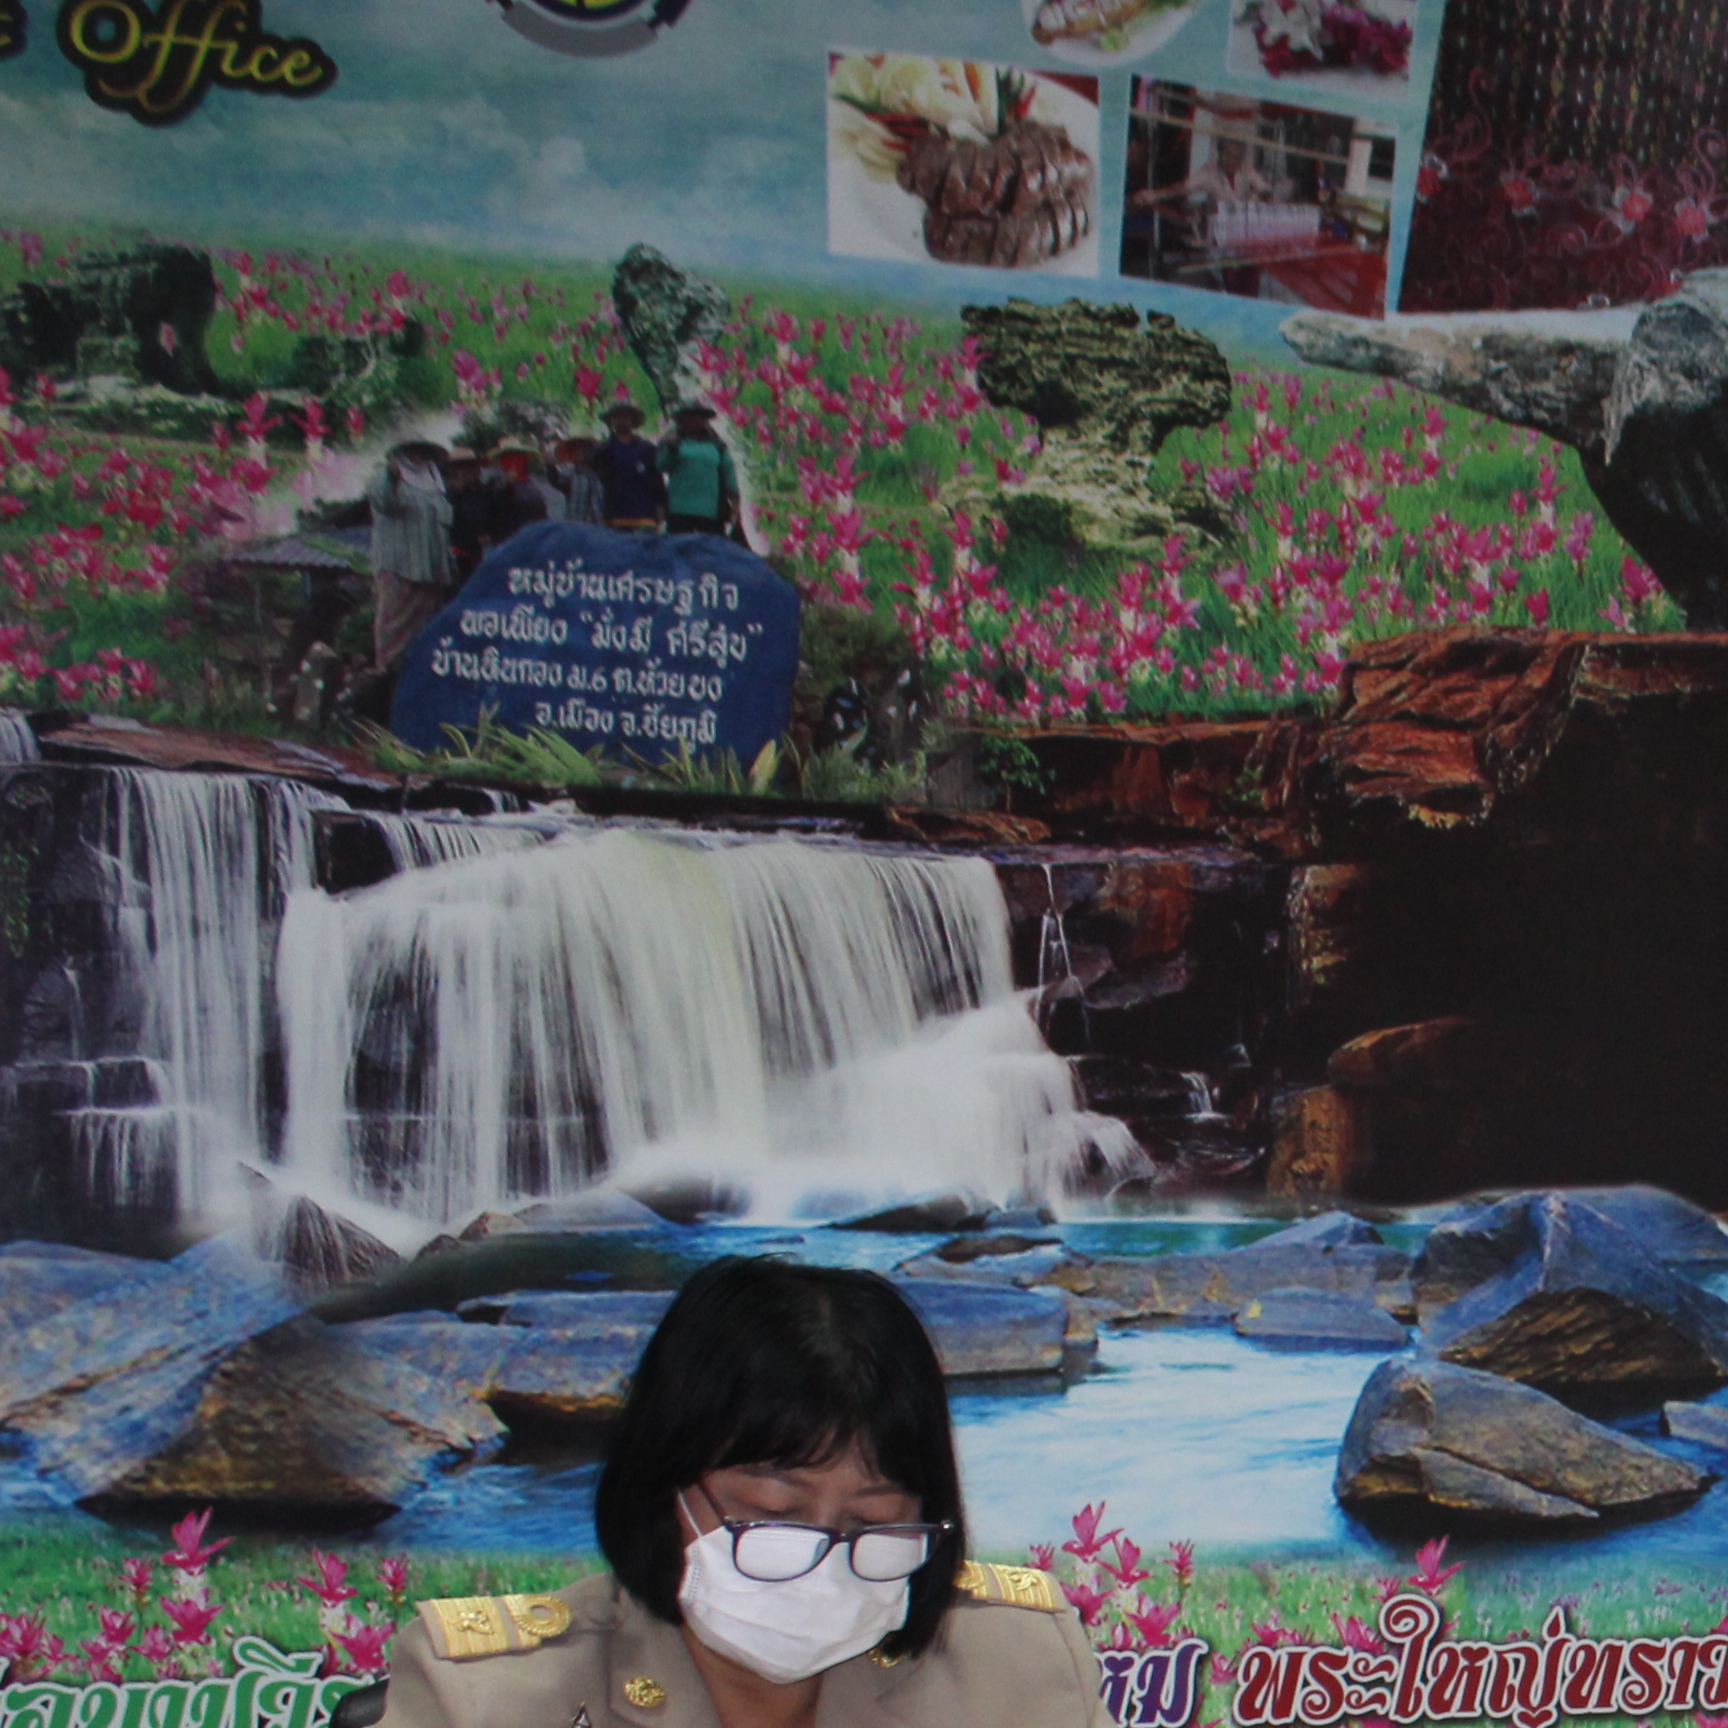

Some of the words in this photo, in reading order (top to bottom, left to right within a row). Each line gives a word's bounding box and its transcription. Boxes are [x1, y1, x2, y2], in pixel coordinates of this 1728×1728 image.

[68, 0, 323, 113] Office
[460, 603, 568, 646] พอเพียง
[534, 697, 614, 733] อ.เมือง
